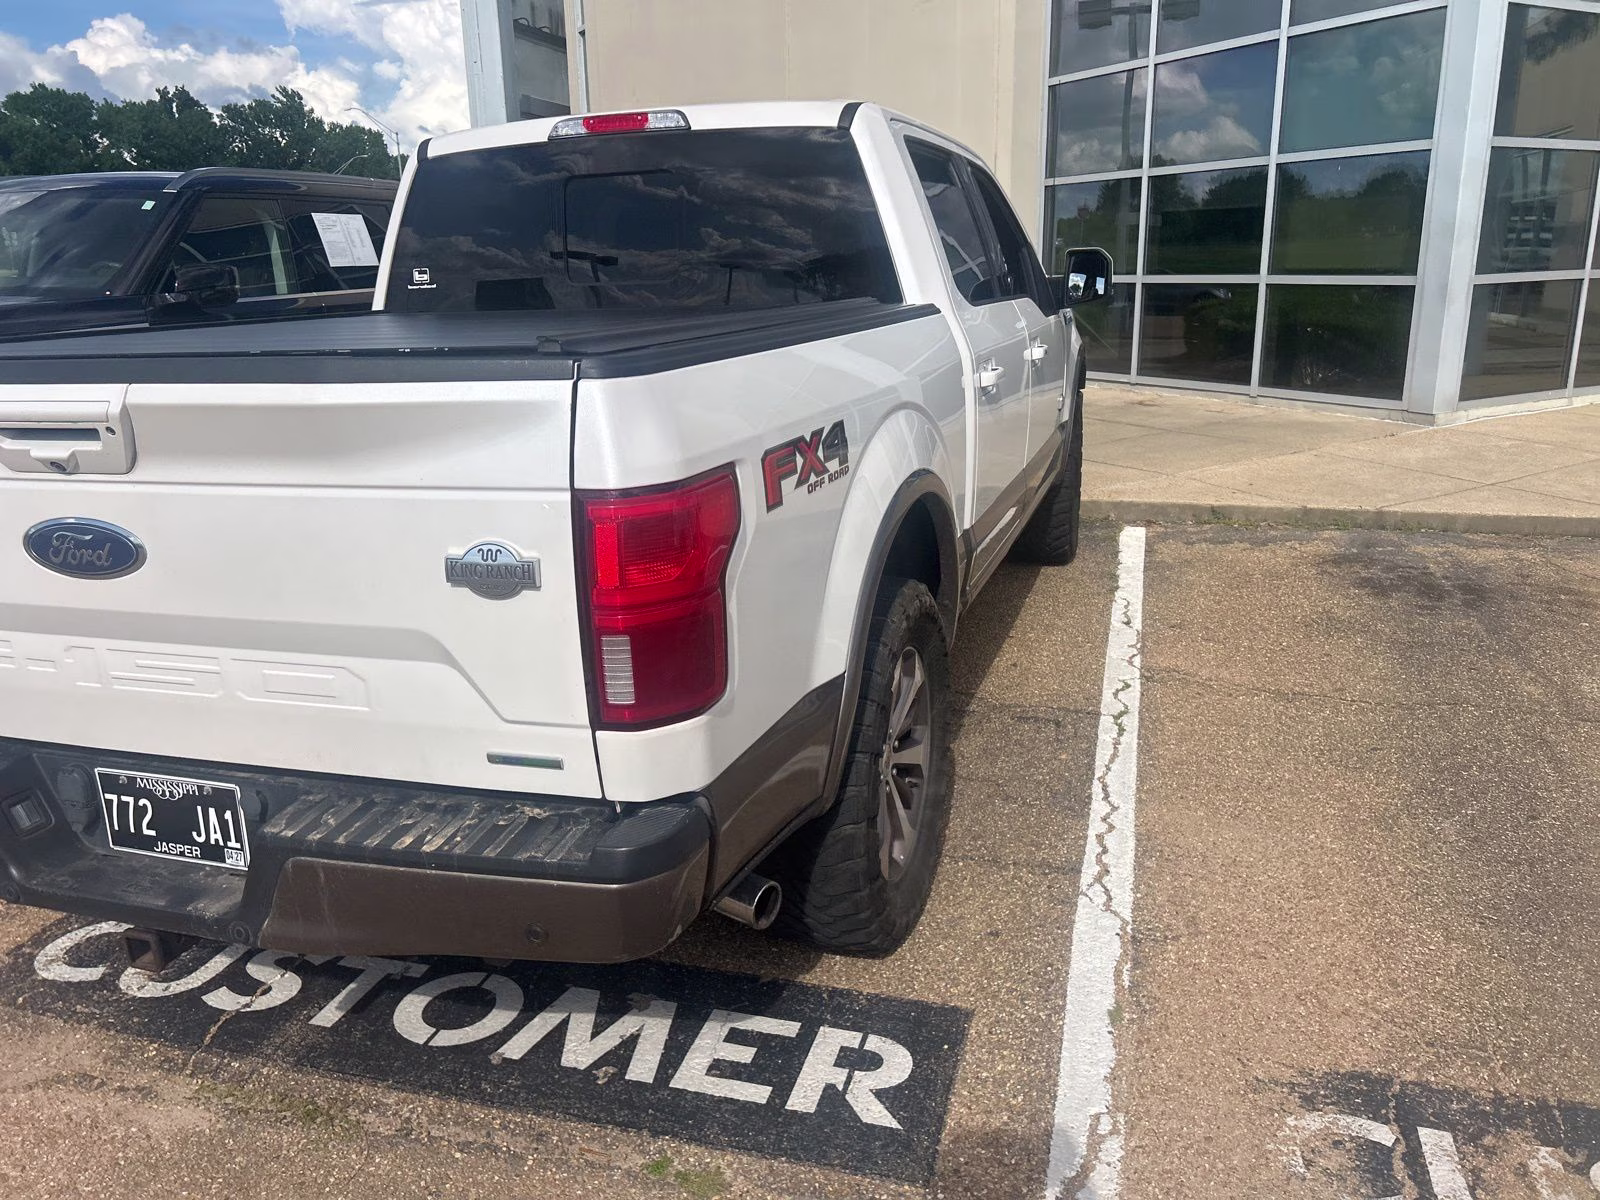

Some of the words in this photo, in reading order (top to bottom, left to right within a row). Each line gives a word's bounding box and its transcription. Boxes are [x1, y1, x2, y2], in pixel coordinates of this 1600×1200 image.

[761, 419, 848, 513] FX4
[807, 477, 825, 494] OFF
[828, 465, 849, 484] ROAD
[49, 531, 112, 566] Ford
[450, 561, 483, 579] KING
[486, 562, 531, 580] RANCH
[136, 777, 199, 801] MISSISSIPPI
[104, 793, 157, 836] 772
[192, 805, 241, 849] JA1
[154, 841, 201, 858] JASPER
[34, 921, 913, 1130] CUSTOMER
